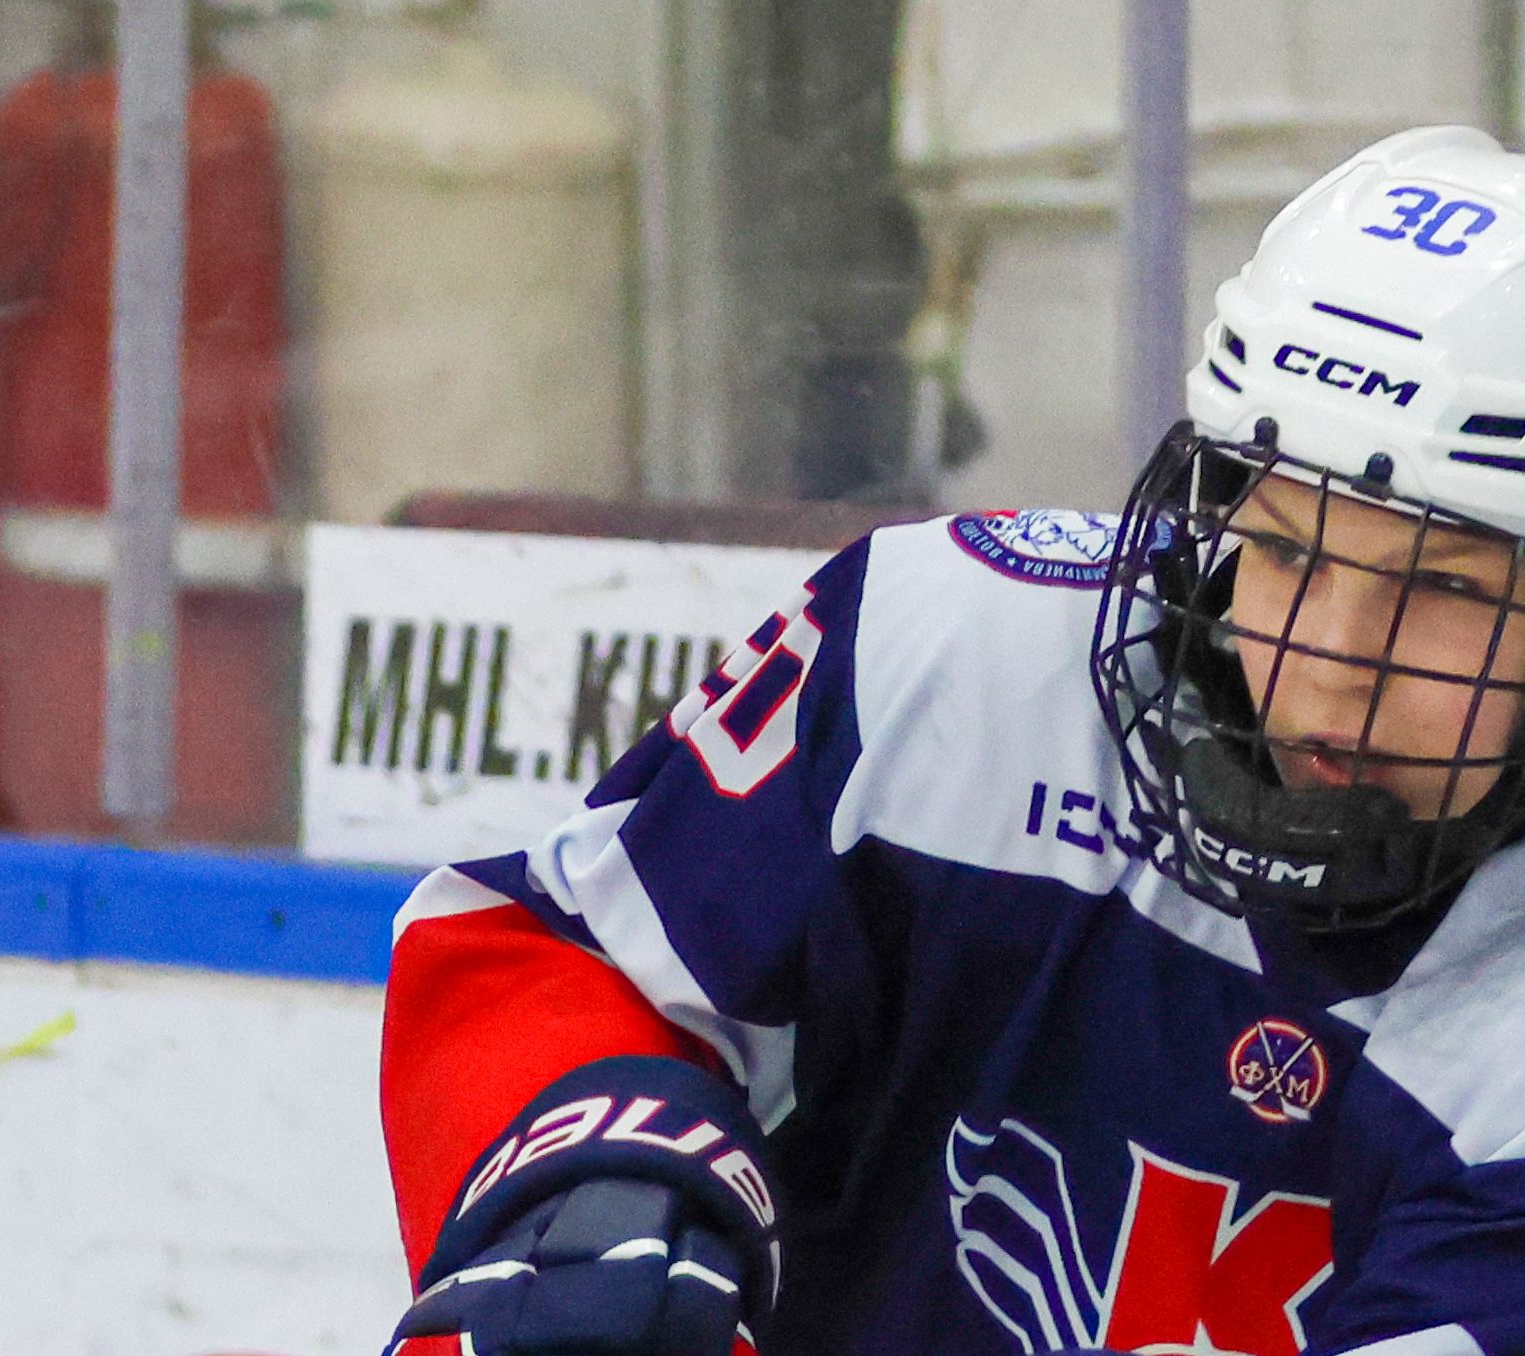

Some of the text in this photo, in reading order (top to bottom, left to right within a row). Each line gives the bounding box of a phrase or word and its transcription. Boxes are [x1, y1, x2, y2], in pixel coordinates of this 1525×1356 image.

[1362, 185, 1496, 258] 30
[1273, 342, 1421, 408] CCM
[332, 615, 728, 783] MHL.KH
[1238, 1060, 1311, 1104] ФХМ
